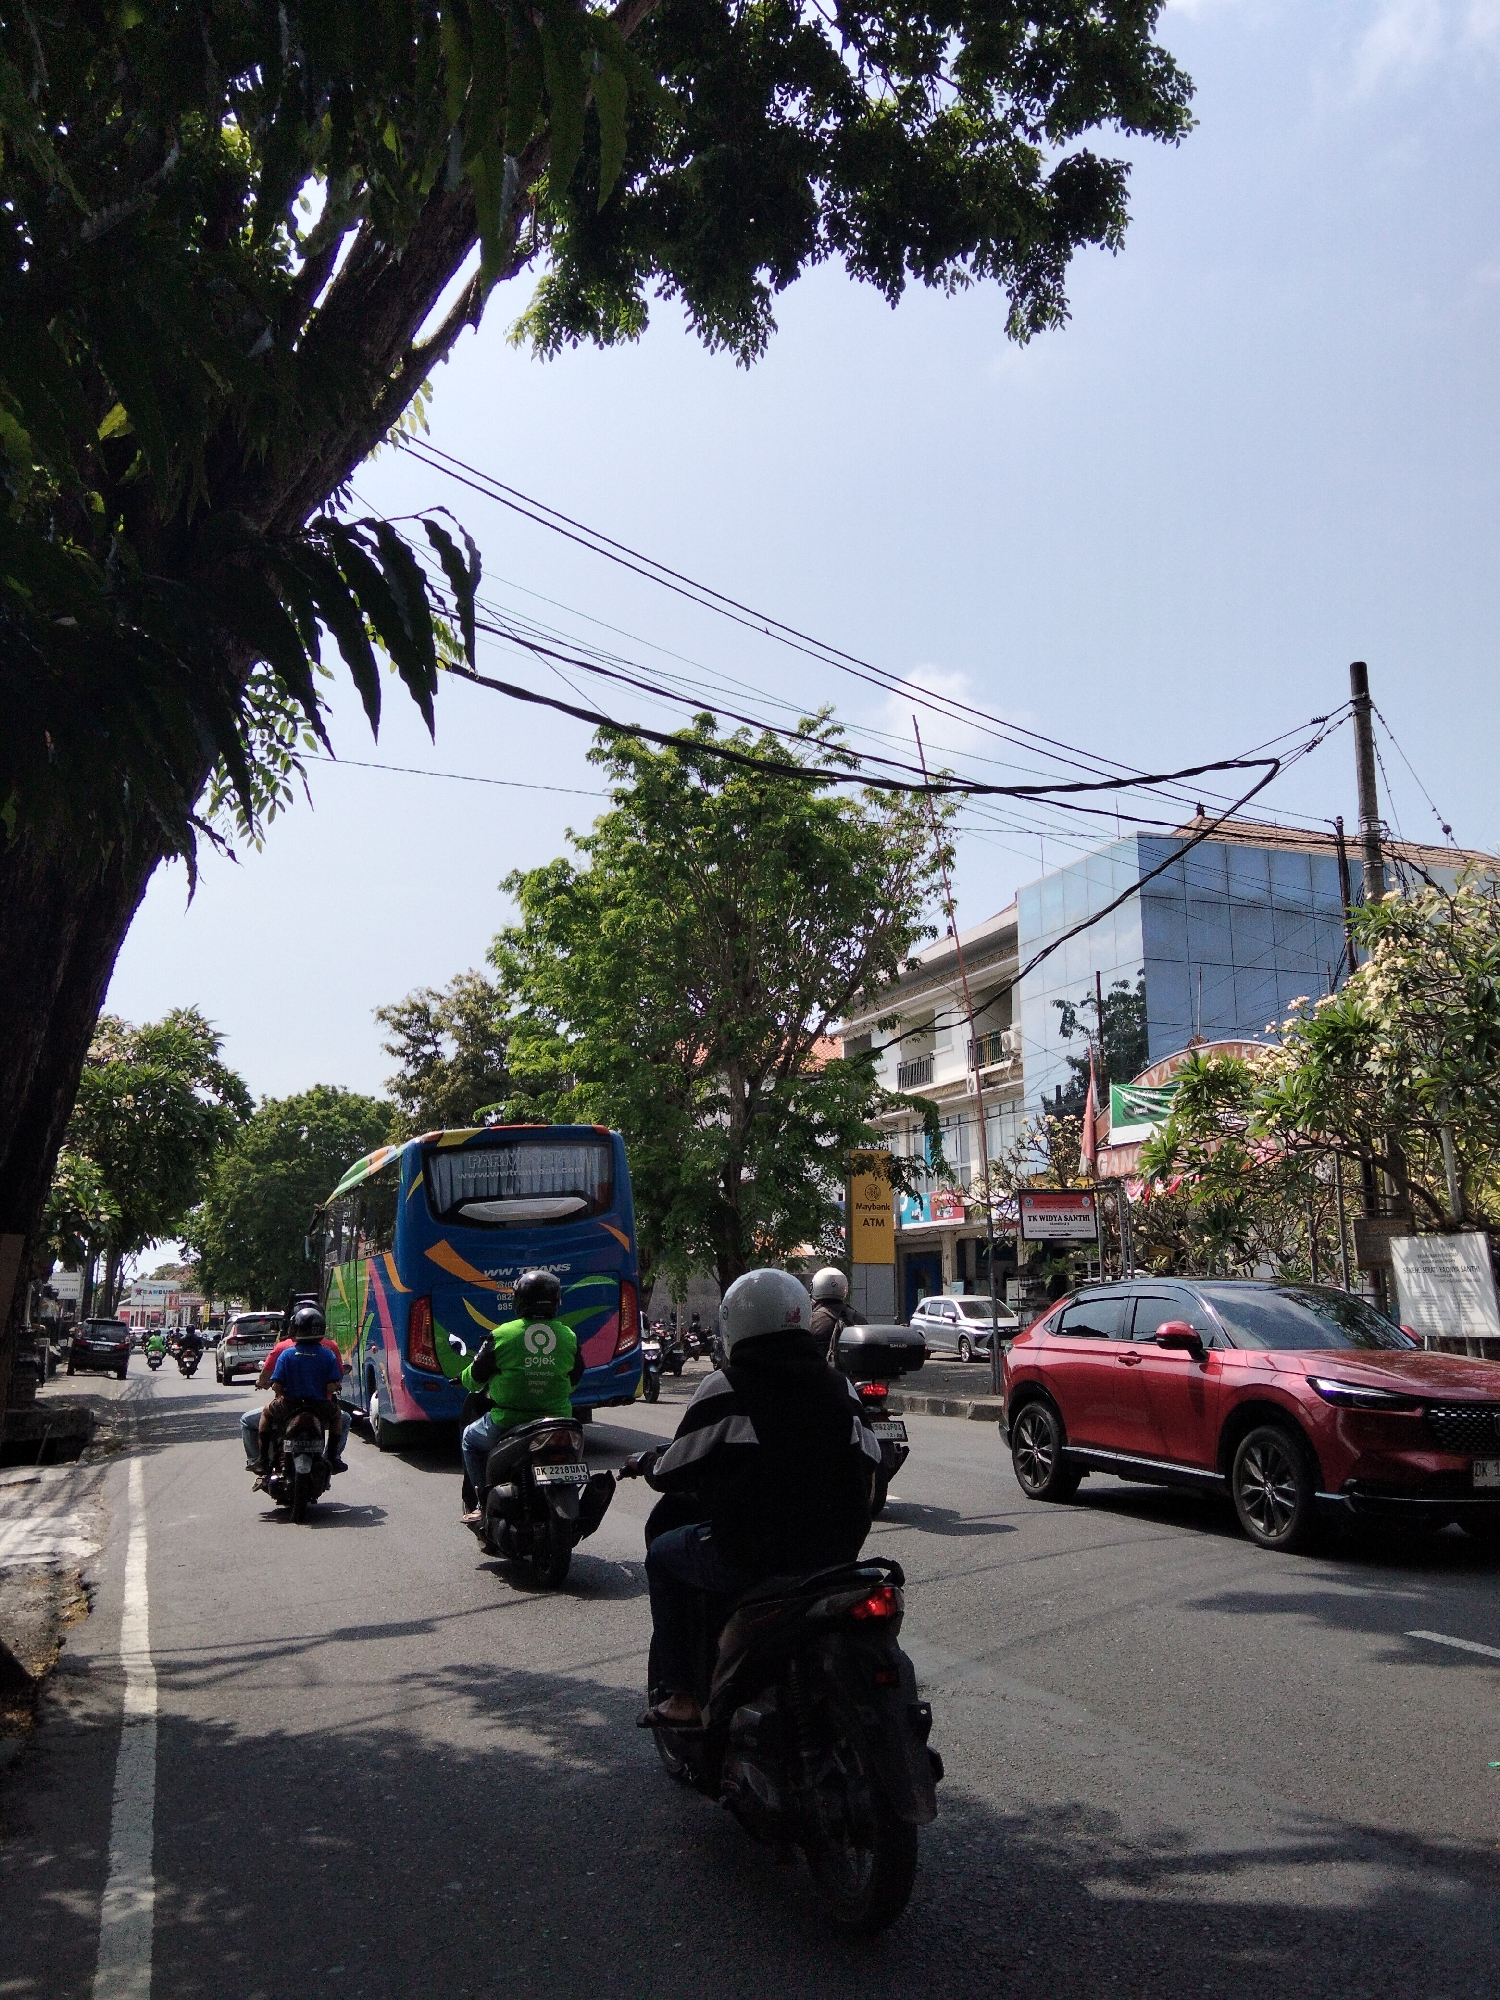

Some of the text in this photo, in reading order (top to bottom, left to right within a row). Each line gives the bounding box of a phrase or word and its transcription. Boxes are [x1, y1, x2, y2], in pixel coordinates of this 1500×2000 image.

[855, 1202, 891, 1212] Maybank
[862, 1217, 885, 1227] ATM
[1039, 1214, 1063, 1222] WIDYA
[1063, 1214, 1090, 1222] SANTHI
[483, 1263, 572, 1278] WW TRANS
[524, 1355, 556, 1368] gojek
[535, 1467, 547, 1476] DK
[1475, 1462, 1488, 1477] DK
